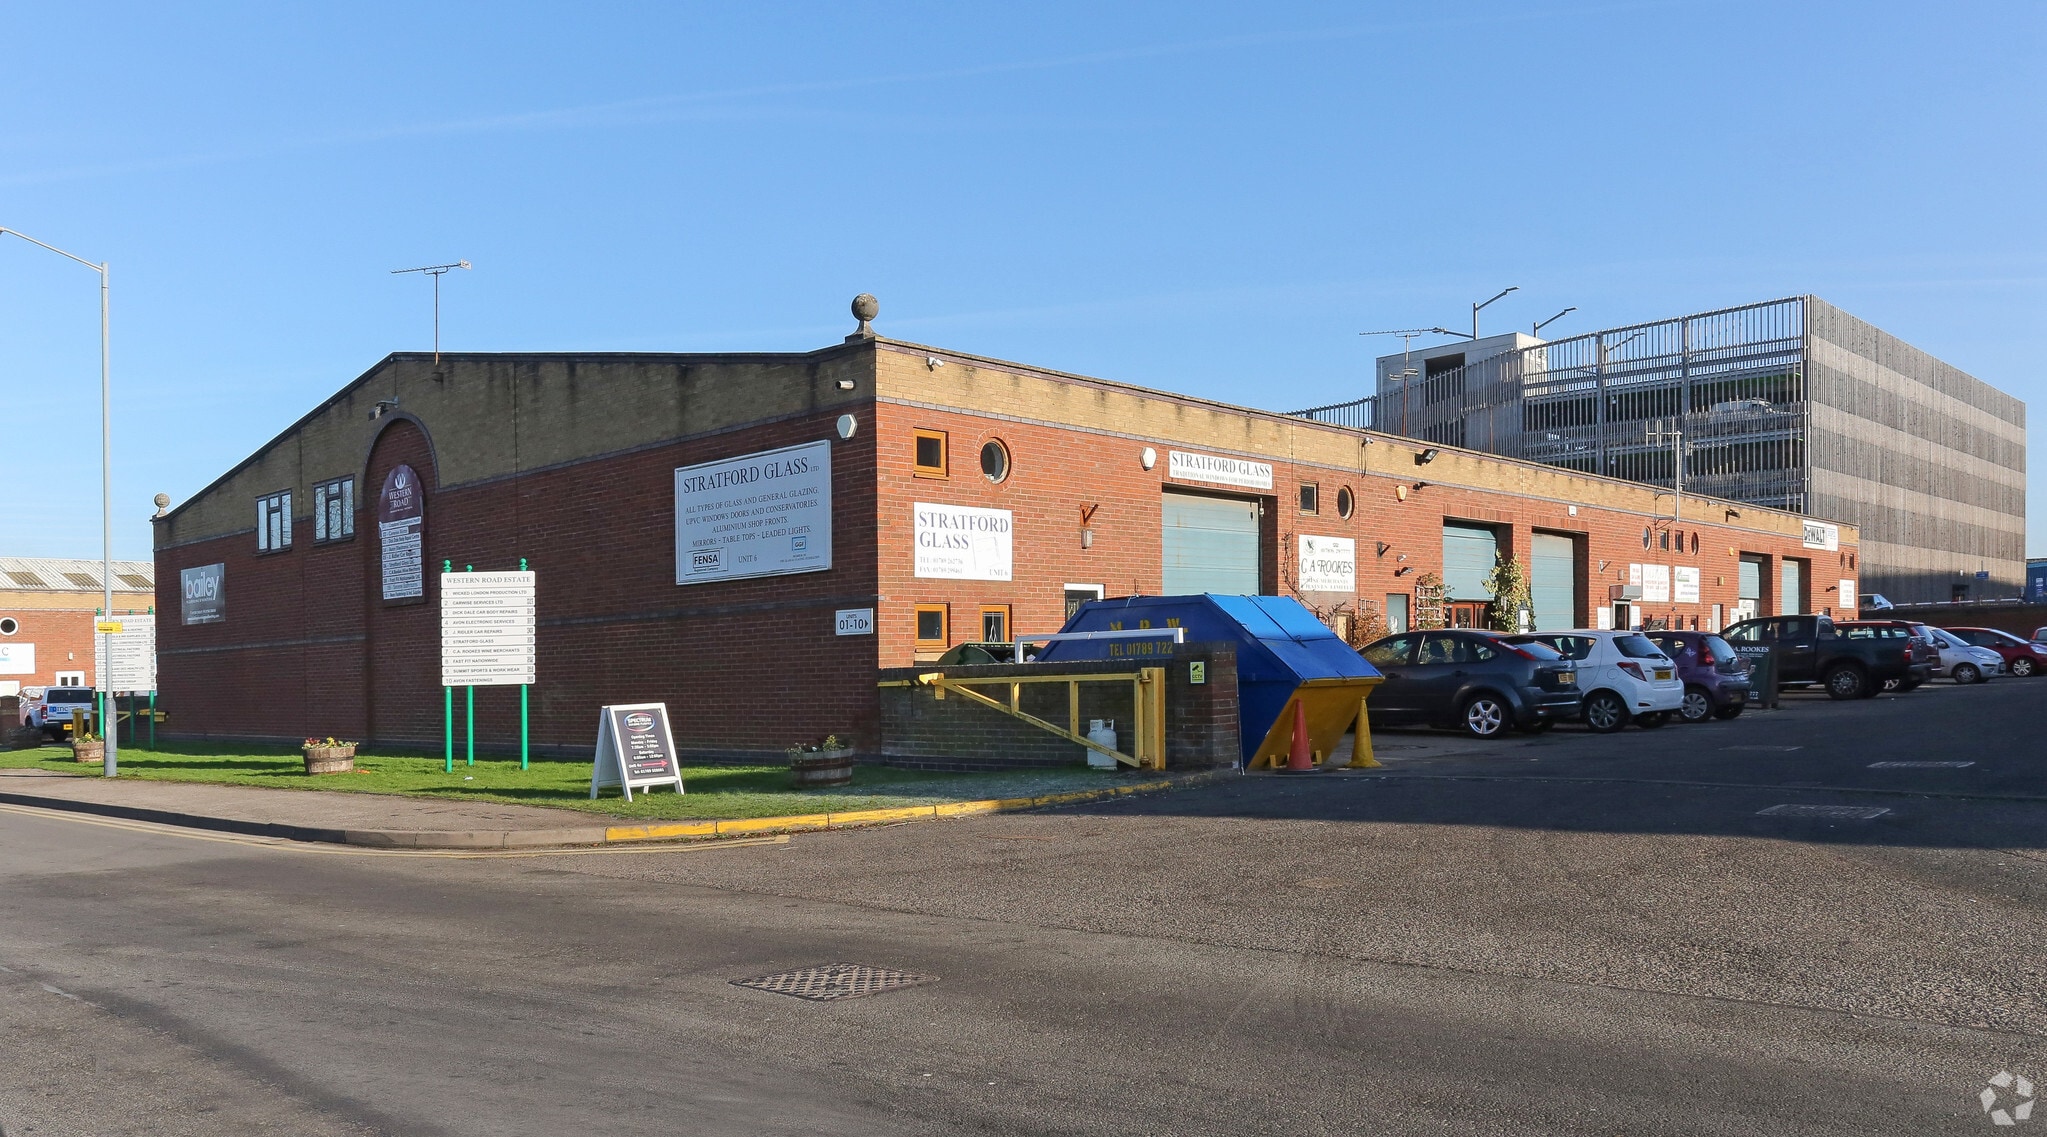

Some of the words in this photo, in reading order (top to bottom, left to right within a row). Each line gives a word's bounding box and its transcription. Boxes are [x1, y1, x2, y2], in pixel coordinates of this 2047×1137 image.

[1172, 453, 1235, 473] STRATFORD
[1238, 462, 1270, 478] GLASS
[684, 466, 759, 493] STRATFORD
[764, 457, 808, 480] GLASS
[389, 487, 412, 500] WESTERN
[393, 497, 408, 508] ROAD
[697, 503, 714, 512] TYPES
[724, 498, 742, 509] GLASS
[744, 496, 757, 506] AND
[758, 491, 787, 503] GENERAL
[686, 516, 701, 526] UPVC
[702, 512, 729, 523] WINDOWS
[730, 509, 749, 518] DOORS
[751, 507, 764, 516] AND
[919, 511, 1008, 533] STRATFORD
[712, 522, 746, 534] ALUMINIUM
[748, 520, 763, 528] SHOP
[692, 539, 717, 547] MIRRORS
[722, 535, 740, 543] TABLE
[742, 532, 755, 540] TOPS
[762, 529, 786, 539] LEADED
[920, 531, 969, 550] GLASS
[694, 555, 718, 564] FENSA
[738, 555, 753, 563] UNIT
[1301, 558, 1307, 574] C
[1310, 560, 1315, 572] A
[1317, 560, 1352, 577] ROOKES
[186, 572, 219, 600] bailey
[840, 619, 864, 630] 01-10
[1110, 644, 1124, 656] TEL
[1127, 642, 1152, 655] 01789
